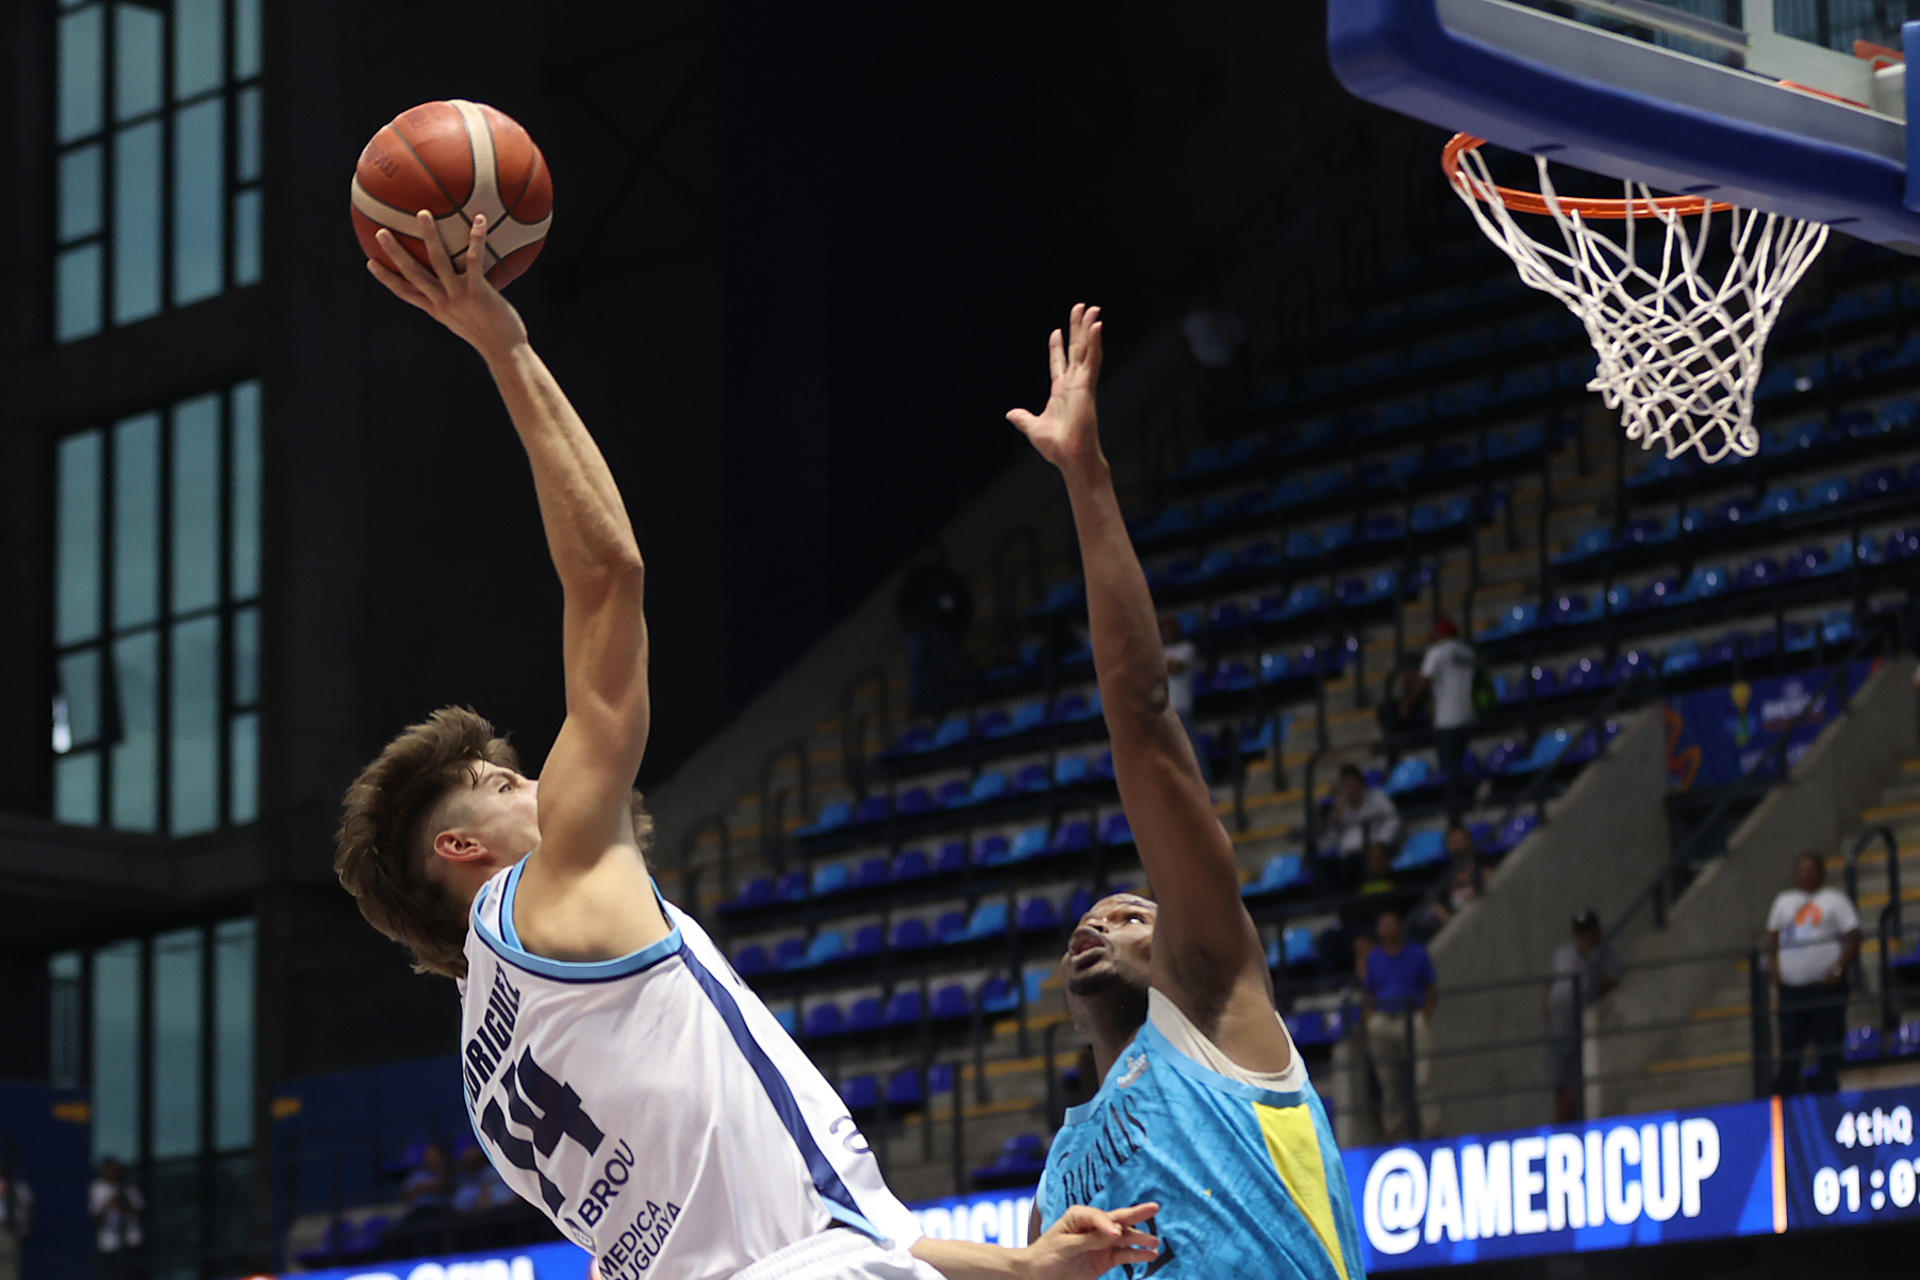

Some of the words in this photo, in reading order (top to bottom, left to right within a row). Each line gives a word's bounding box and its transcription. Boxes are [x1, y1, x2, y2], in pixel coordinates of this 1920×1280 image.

[464, 961, 521, 1116] DRIGUEZ
[481, 1043, 605, 1218] 14
[1835, 1105, 1913, 1149] 4thQ
[578, 1138, 635, 1228] BROU
[1363, 1117, 1720, 1255] @AMERICUP
[1813, 1157, 1920, 1215] 01:0
[614, 1202, 681, 1280] UGUAYA
